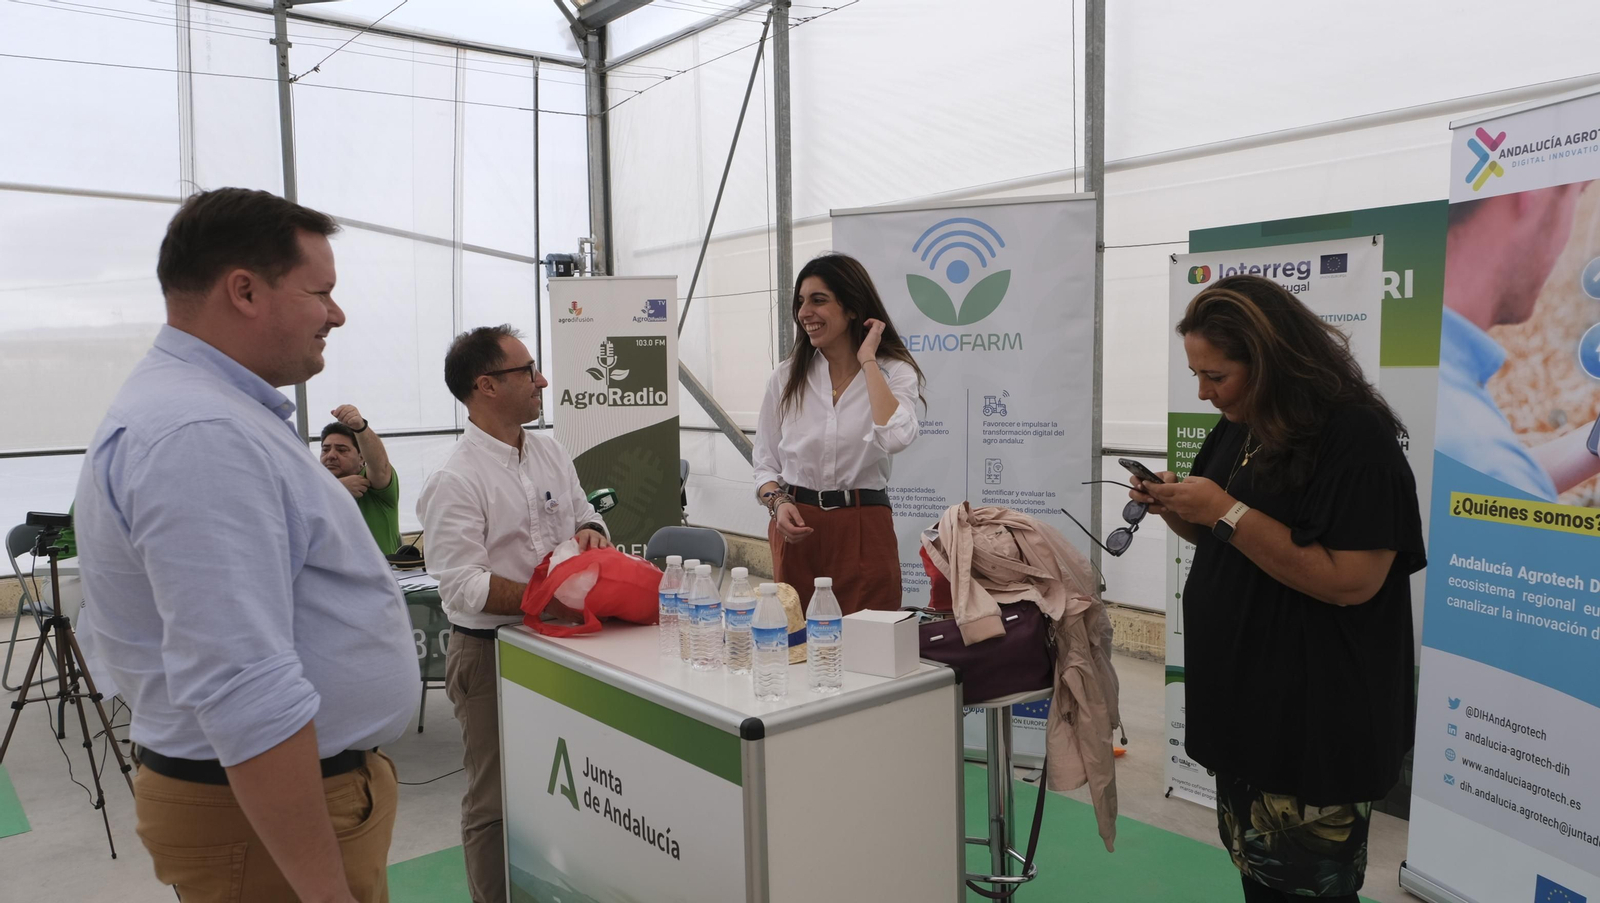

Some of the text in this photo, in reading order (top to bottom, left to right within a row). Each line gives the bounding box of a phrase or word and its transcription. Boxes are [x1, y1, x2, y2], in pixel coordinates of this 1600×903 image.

[1498, 136, 1562, 159] ANDALUCÍA
[1512, 145, 1598, 168] DIGITAL INNOVATIO
[560, 387, 667, 410] AgroRadio
[1032, 430, 1053, 438] digital
[1177, 427, 1206, 438] HUB
[1453, 497, 1528, 521] ¿Quiénes
[1450, 554, 1513, 577] Andalucía
[1518, 566, 1584, 590] Agrotech
[1448, 576, 1515, 598] ecosistema
[1522, 590, 1575, 612] regional
[1447, 596, 1500, 616] canalizar
[1502, 606, 1512, 620] la
[1516, 609, 1587, 637] innovación
[1466, 706, 1546, 741] @DIHAndAgrotech
[1465, 731, 1570, 776] andalucia-agrotech-dih
[583, 756, 622, 796] Junta
[1462, 756, 1582, 810] www.andaluciaagrotech.es
[584, 786, 680, 860] de Andalucía
[1460, 780, 1600, 847] dih.andalucia.agrotech@juntad
